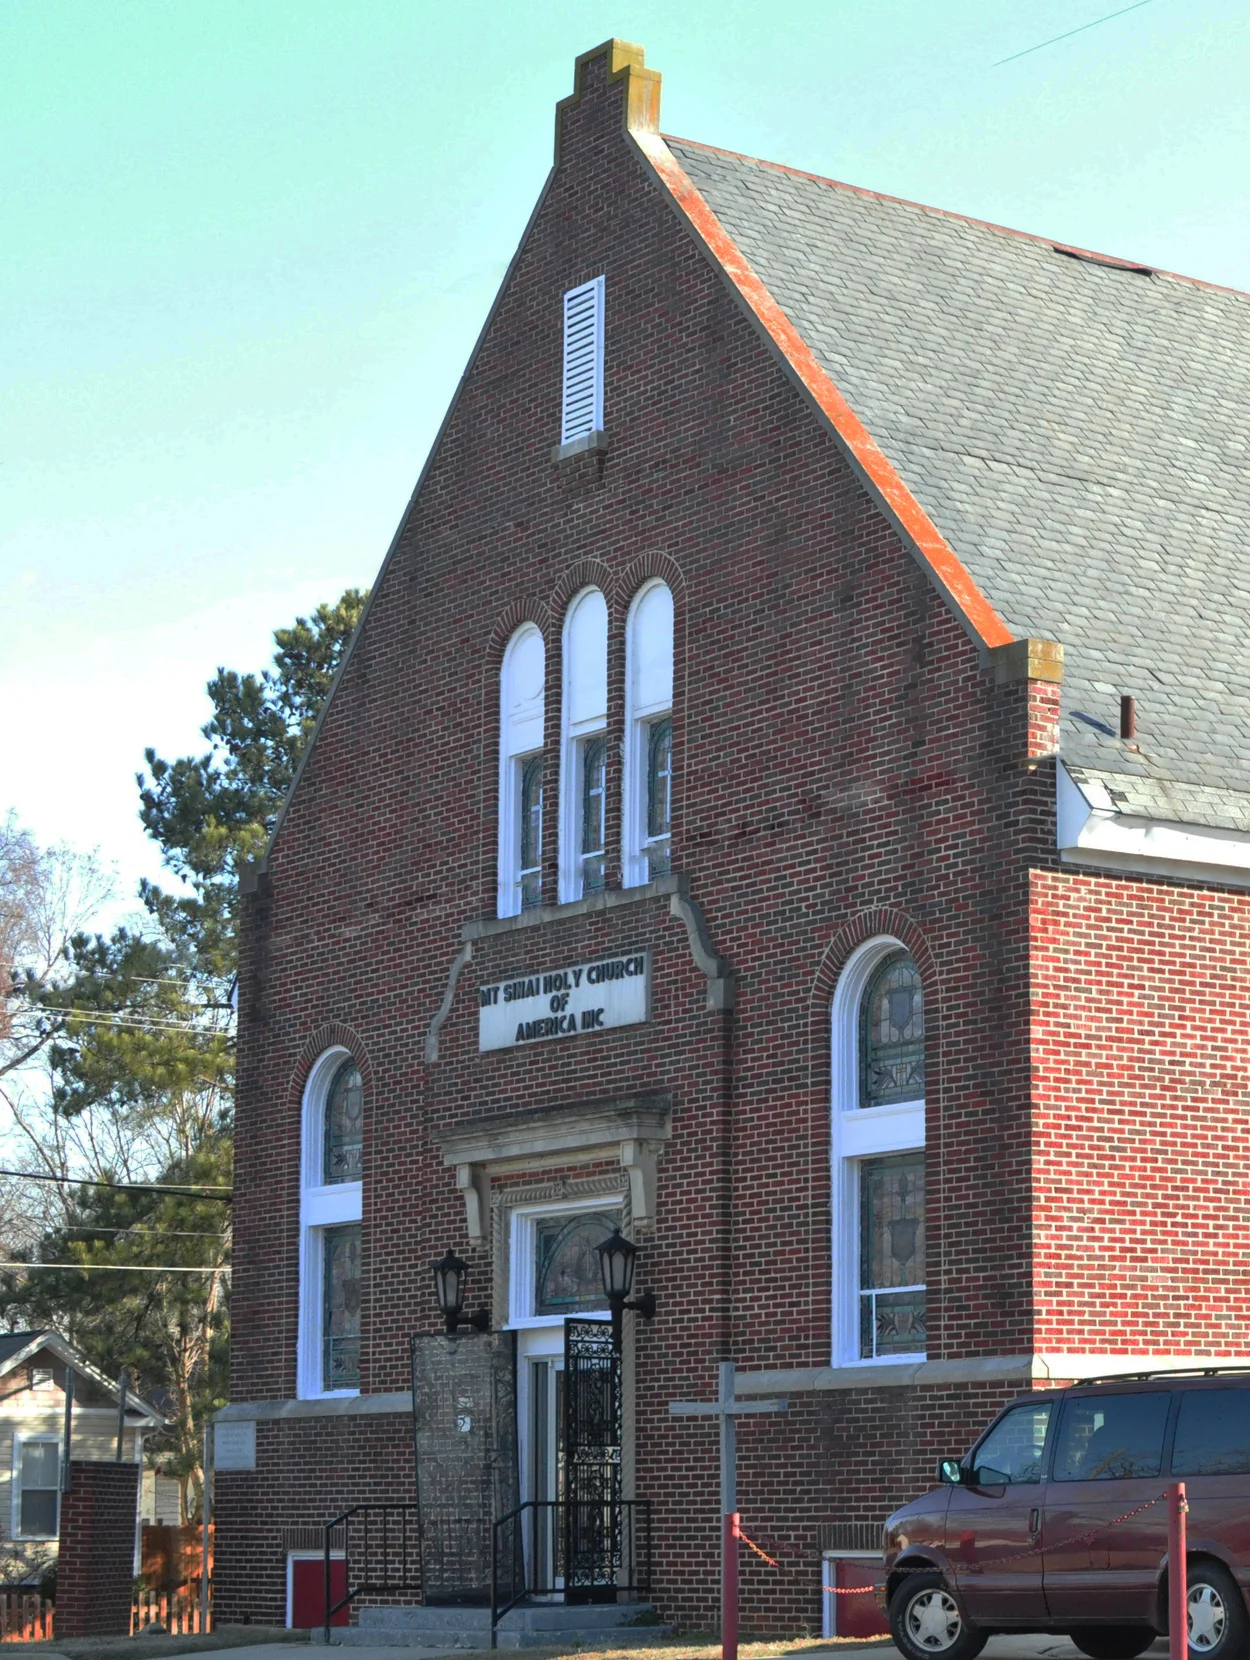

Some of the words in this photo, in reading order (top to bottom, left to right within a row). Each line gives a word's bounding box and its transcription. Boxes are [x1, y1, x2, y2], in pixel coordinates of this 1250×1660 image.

[480, 986, 499, 1007] MT
[503, 977, 540, 1002] SINAI
[543, 968, 583, 994] HOLY
[587, 956, 643, 984] CHURCH
[550, 992, 570, 1013] OF
[515, 1013, 577, 1042] AMERICA
[581, 1008, 604, 1030] INC
